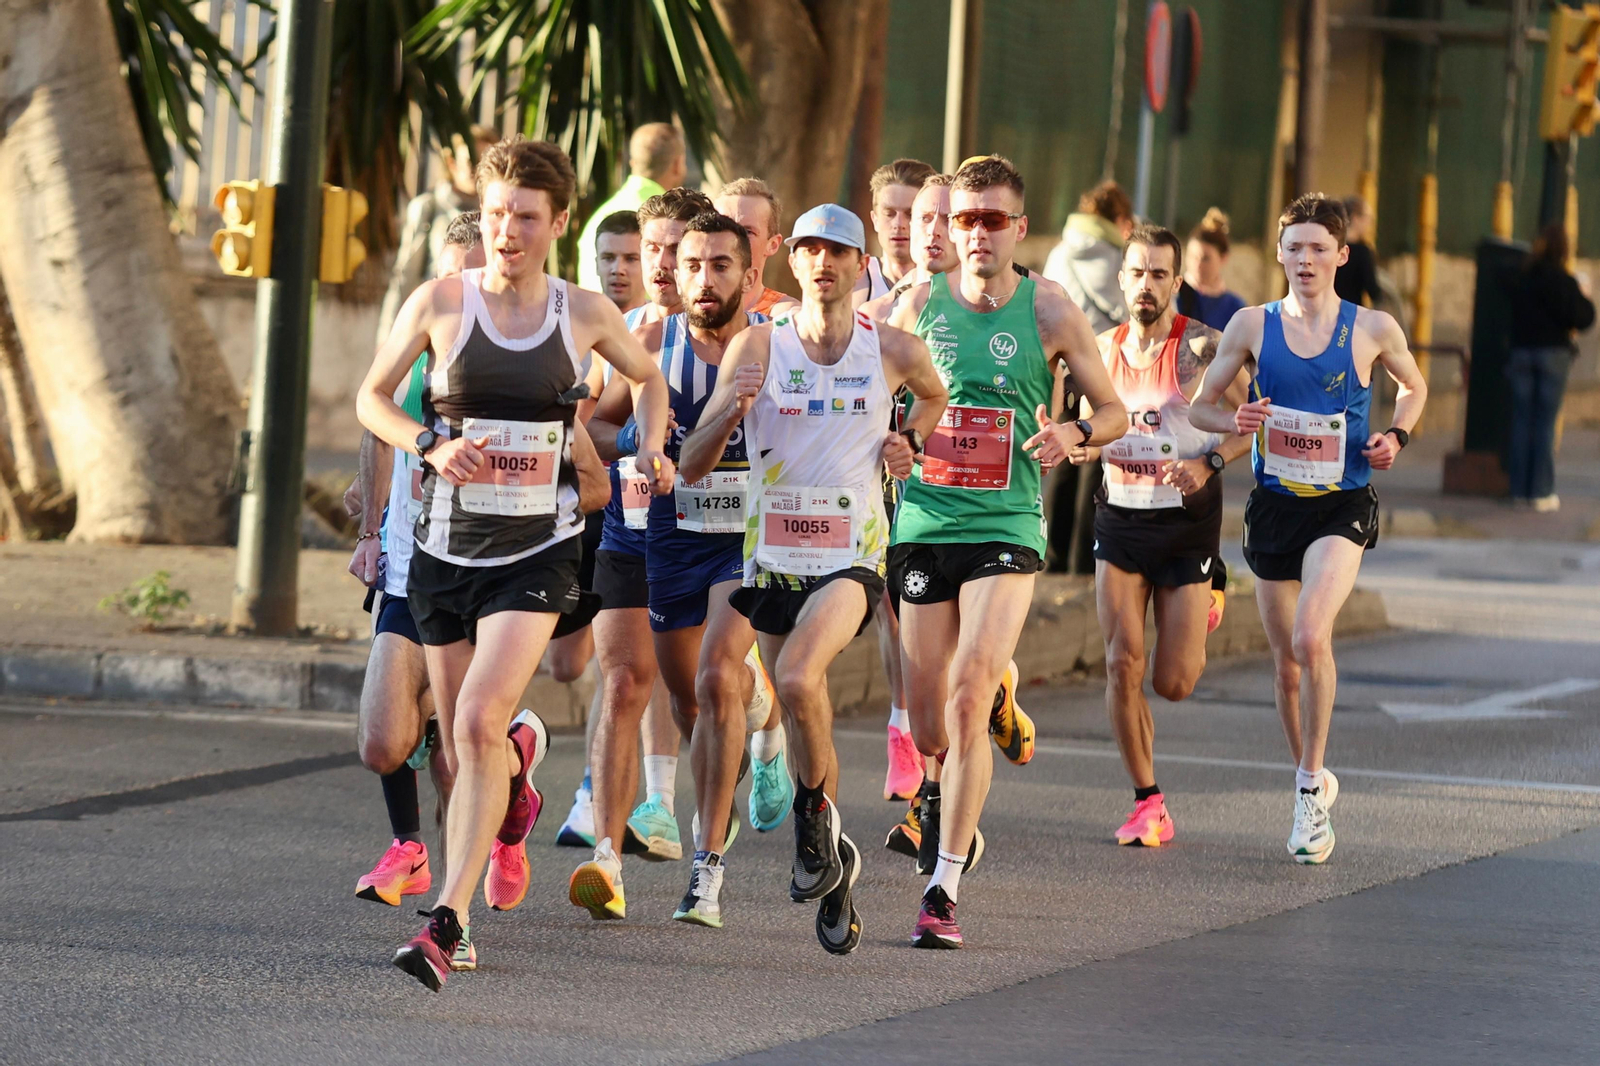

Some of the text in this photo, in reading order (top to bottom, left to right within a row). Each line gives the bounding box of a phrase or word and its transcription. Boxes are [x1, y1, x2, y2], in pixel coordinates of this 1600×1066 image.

[555, 288, 564, 315] soar
[1338, 324, 1349, 348] soar
[780, 408, 802, 416] EJOT
[952, 436, 978, 449] 143
[1284, 435, 1322, 450] 10039
[490, 456, 538, 471] 10052
[1120, 464, 1156, 474] 10013
[694, 496, 740, 510] 14738
[784, 519, 830, 534] 10055
